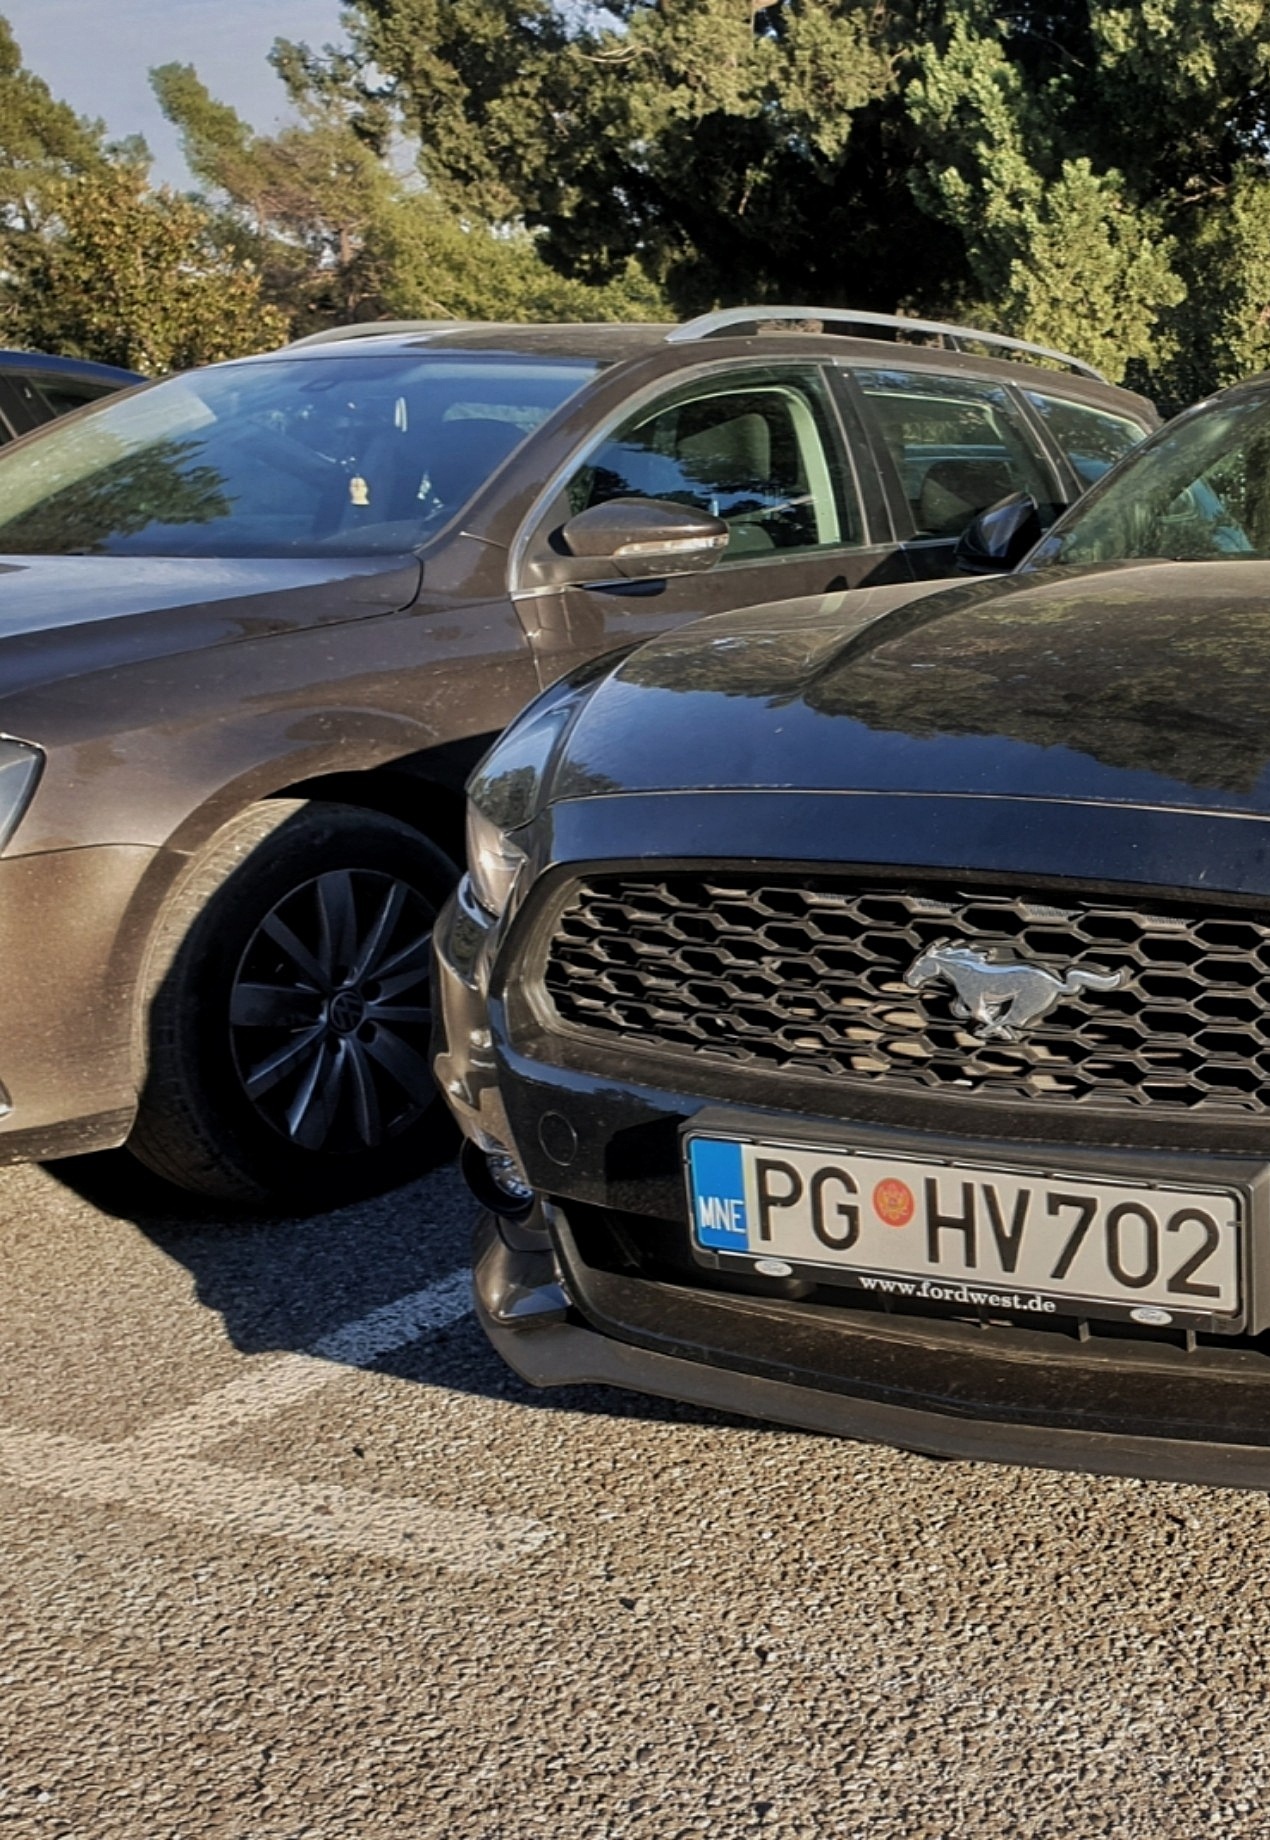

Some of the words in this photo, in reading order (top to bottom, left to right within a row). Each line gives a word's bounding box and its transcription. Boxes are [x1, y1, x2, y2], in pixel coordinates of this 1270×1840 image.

[699, 1196, 744, 1234] MNE
[754, 1158, 860, 1251] PG
[923, 1177, 1221, 1299] HV702
[858, 1276, 1056, 1313] www.fordwest.de
